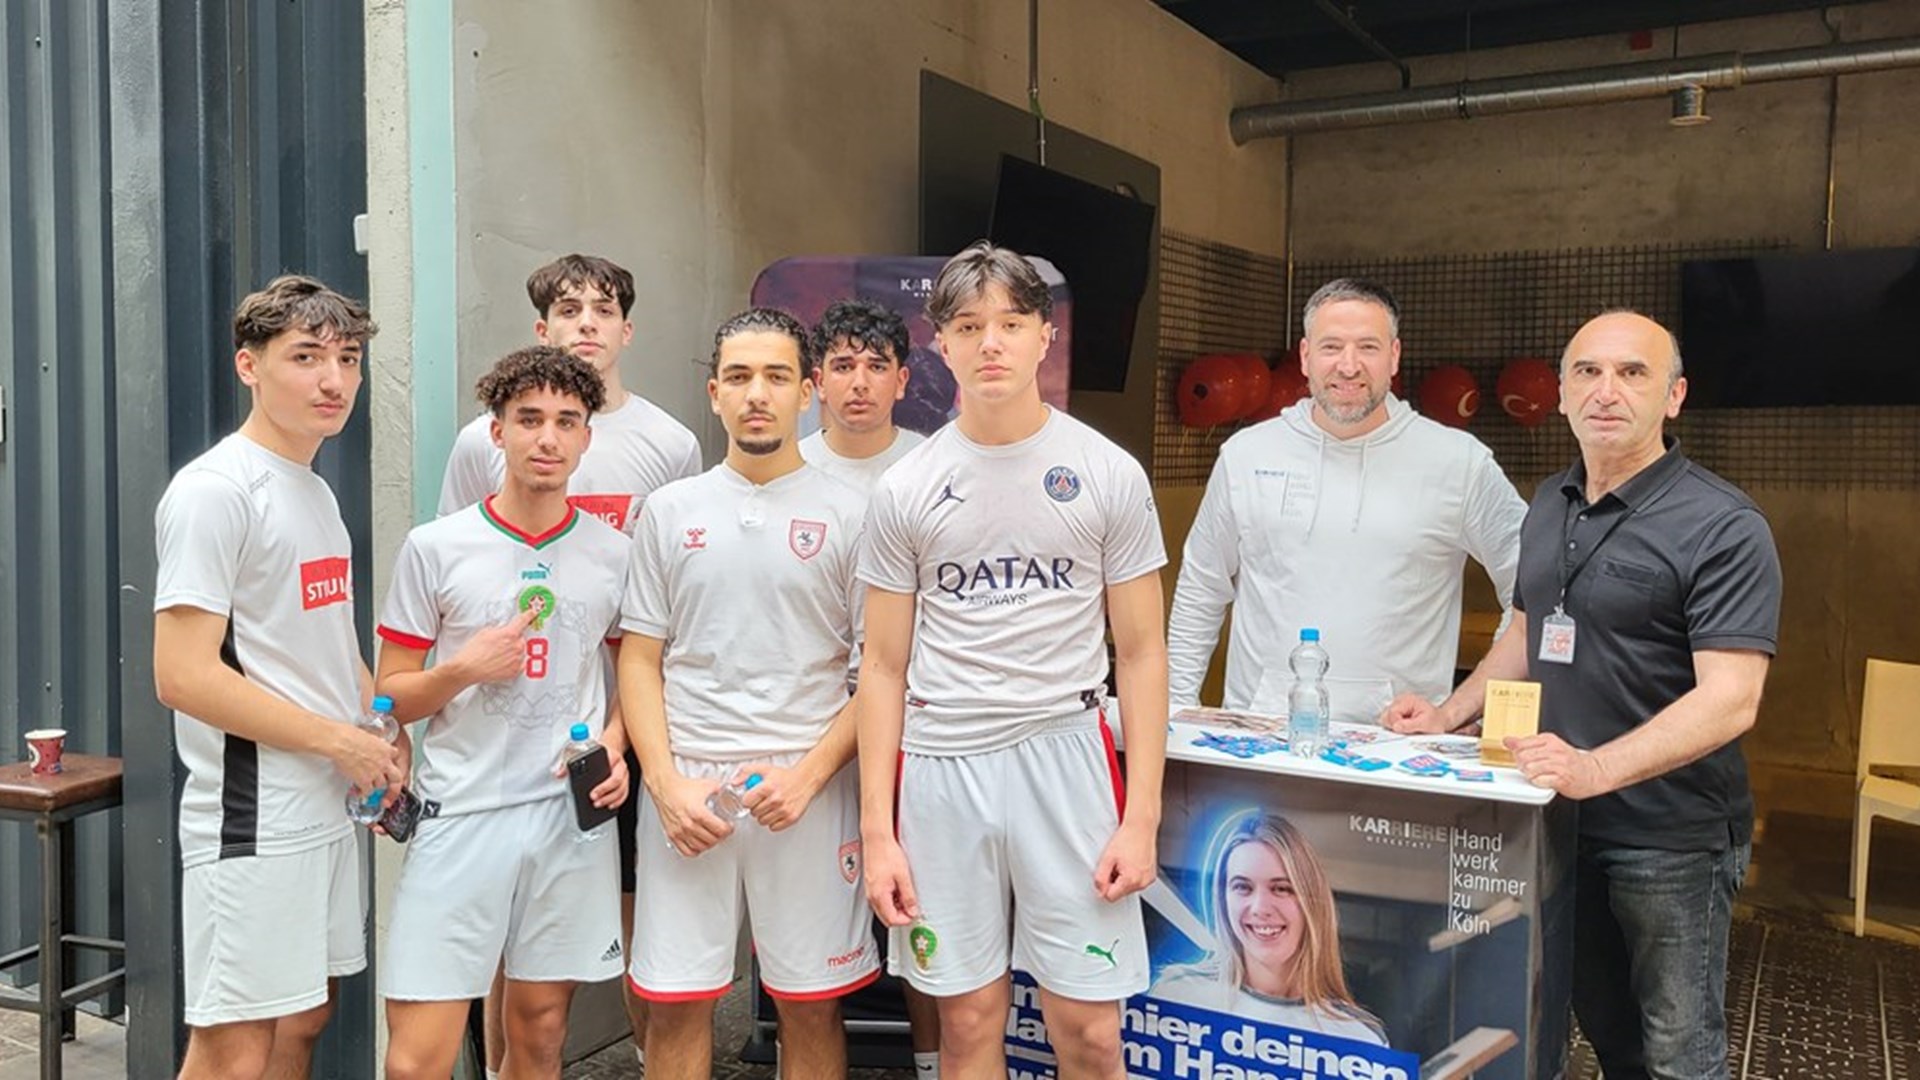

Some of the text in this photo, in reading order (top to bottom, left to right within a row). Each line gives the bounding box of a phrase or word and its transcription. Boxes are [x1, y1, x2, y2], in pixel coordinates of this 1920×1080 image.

[937, 556, 1074, 601] QATAR
[526, 638, 548, 679] 8
[1350, 815, 1447, 842] KARRIERE
[1454, 828, 1502, 851] Hand
[1453, 853, 1499, 873] werk
[1453, 869, 1527, 896] kammer
[1452, 892, 1471, 909] zu
[1452, 911, 1491, 935] Köln
[1120, 998, 1211, 1046] hier
